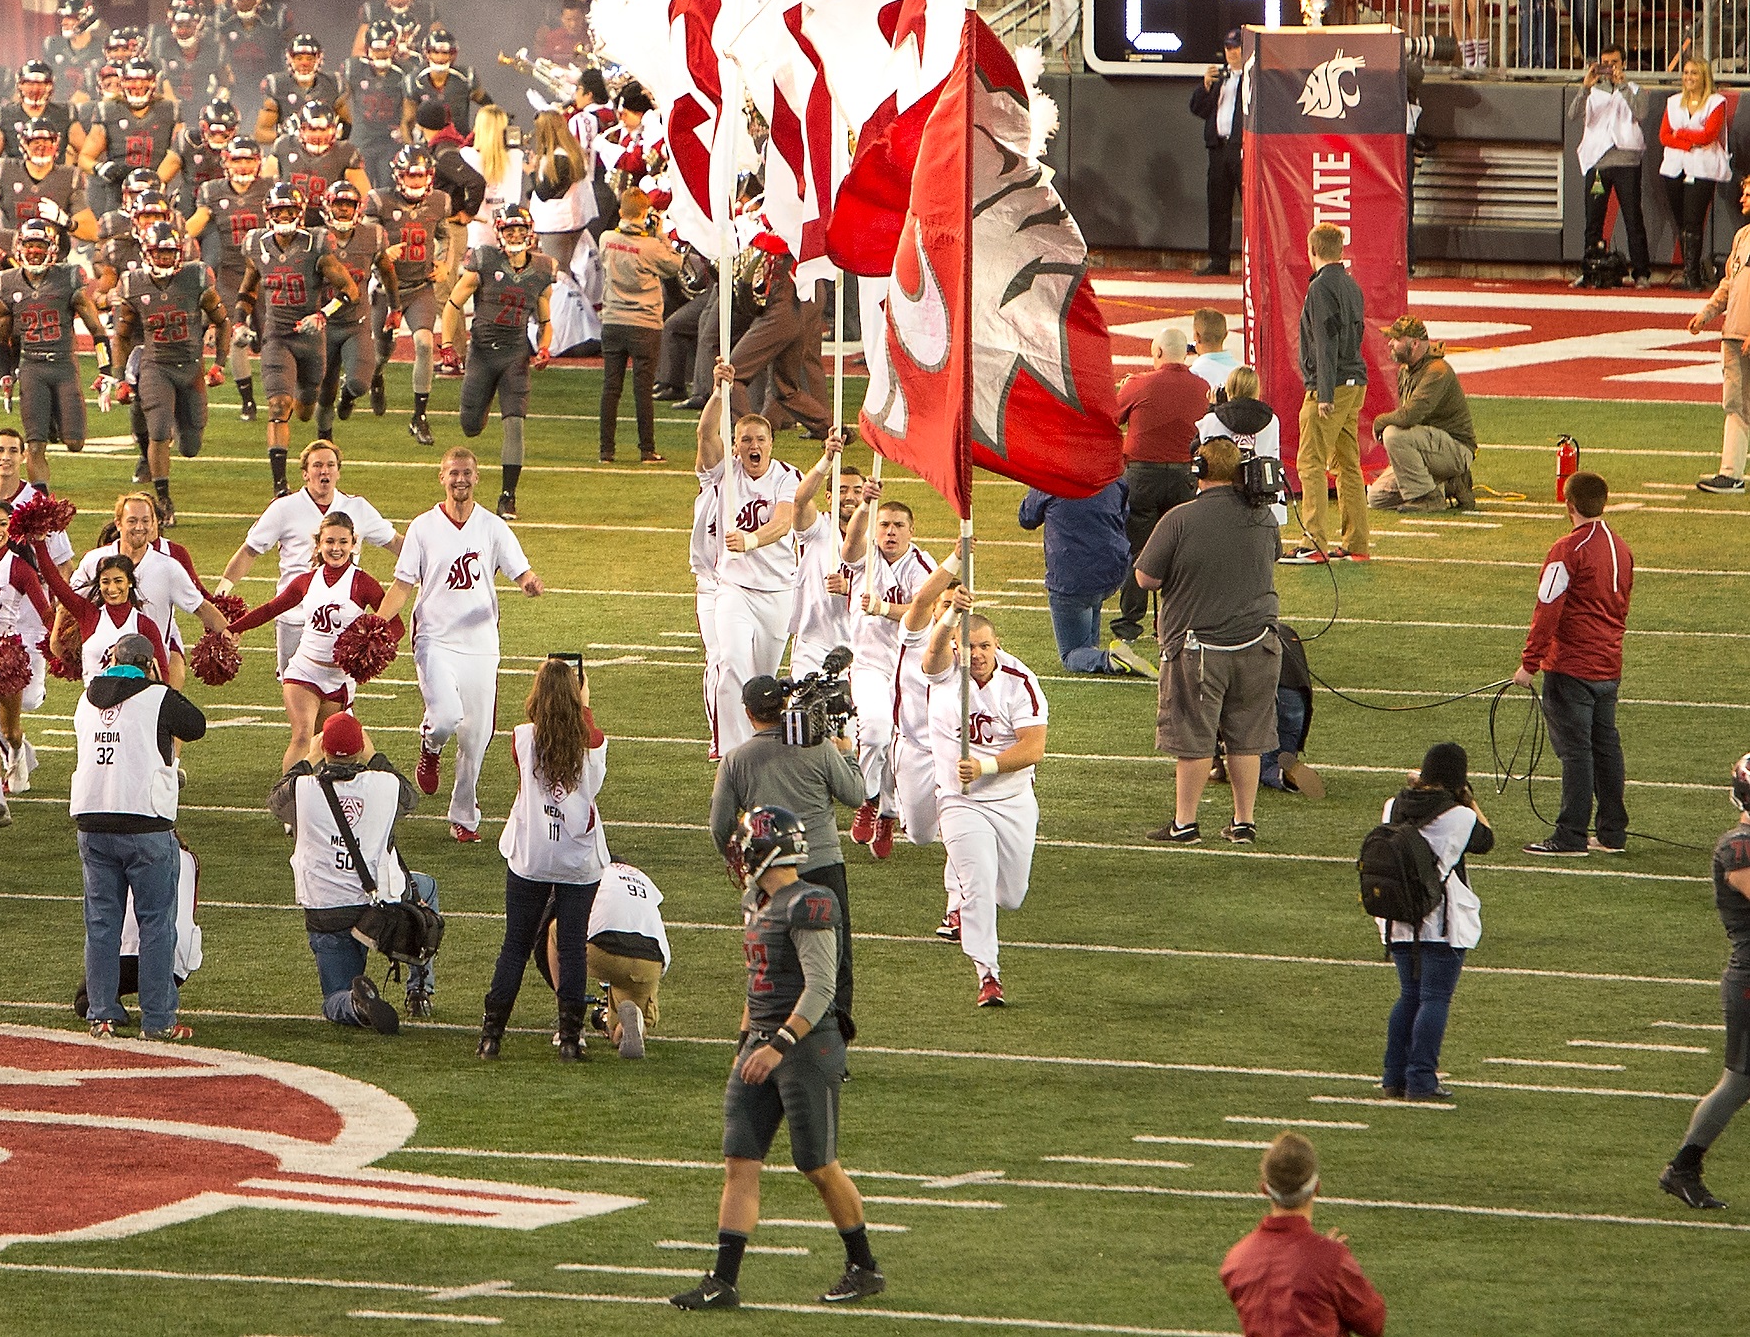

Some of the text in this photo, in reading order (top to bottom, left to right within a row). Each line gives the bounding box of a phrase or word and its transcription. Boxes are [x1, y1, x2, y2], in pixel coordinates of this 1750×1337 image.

[1312, 152, 1351, 246] TATE
[266, 273, 307, 306] 20
[495, 292, 526, 326] 21
[147, 310, 189, 342] 23
[94, 731, 121, 743] MEDIA
[96, 747, 115, 765] 32
[335, 851, 355, 870] 50
[626, 884, 648, 899] 93
[805, 897, 833, 921] 72
